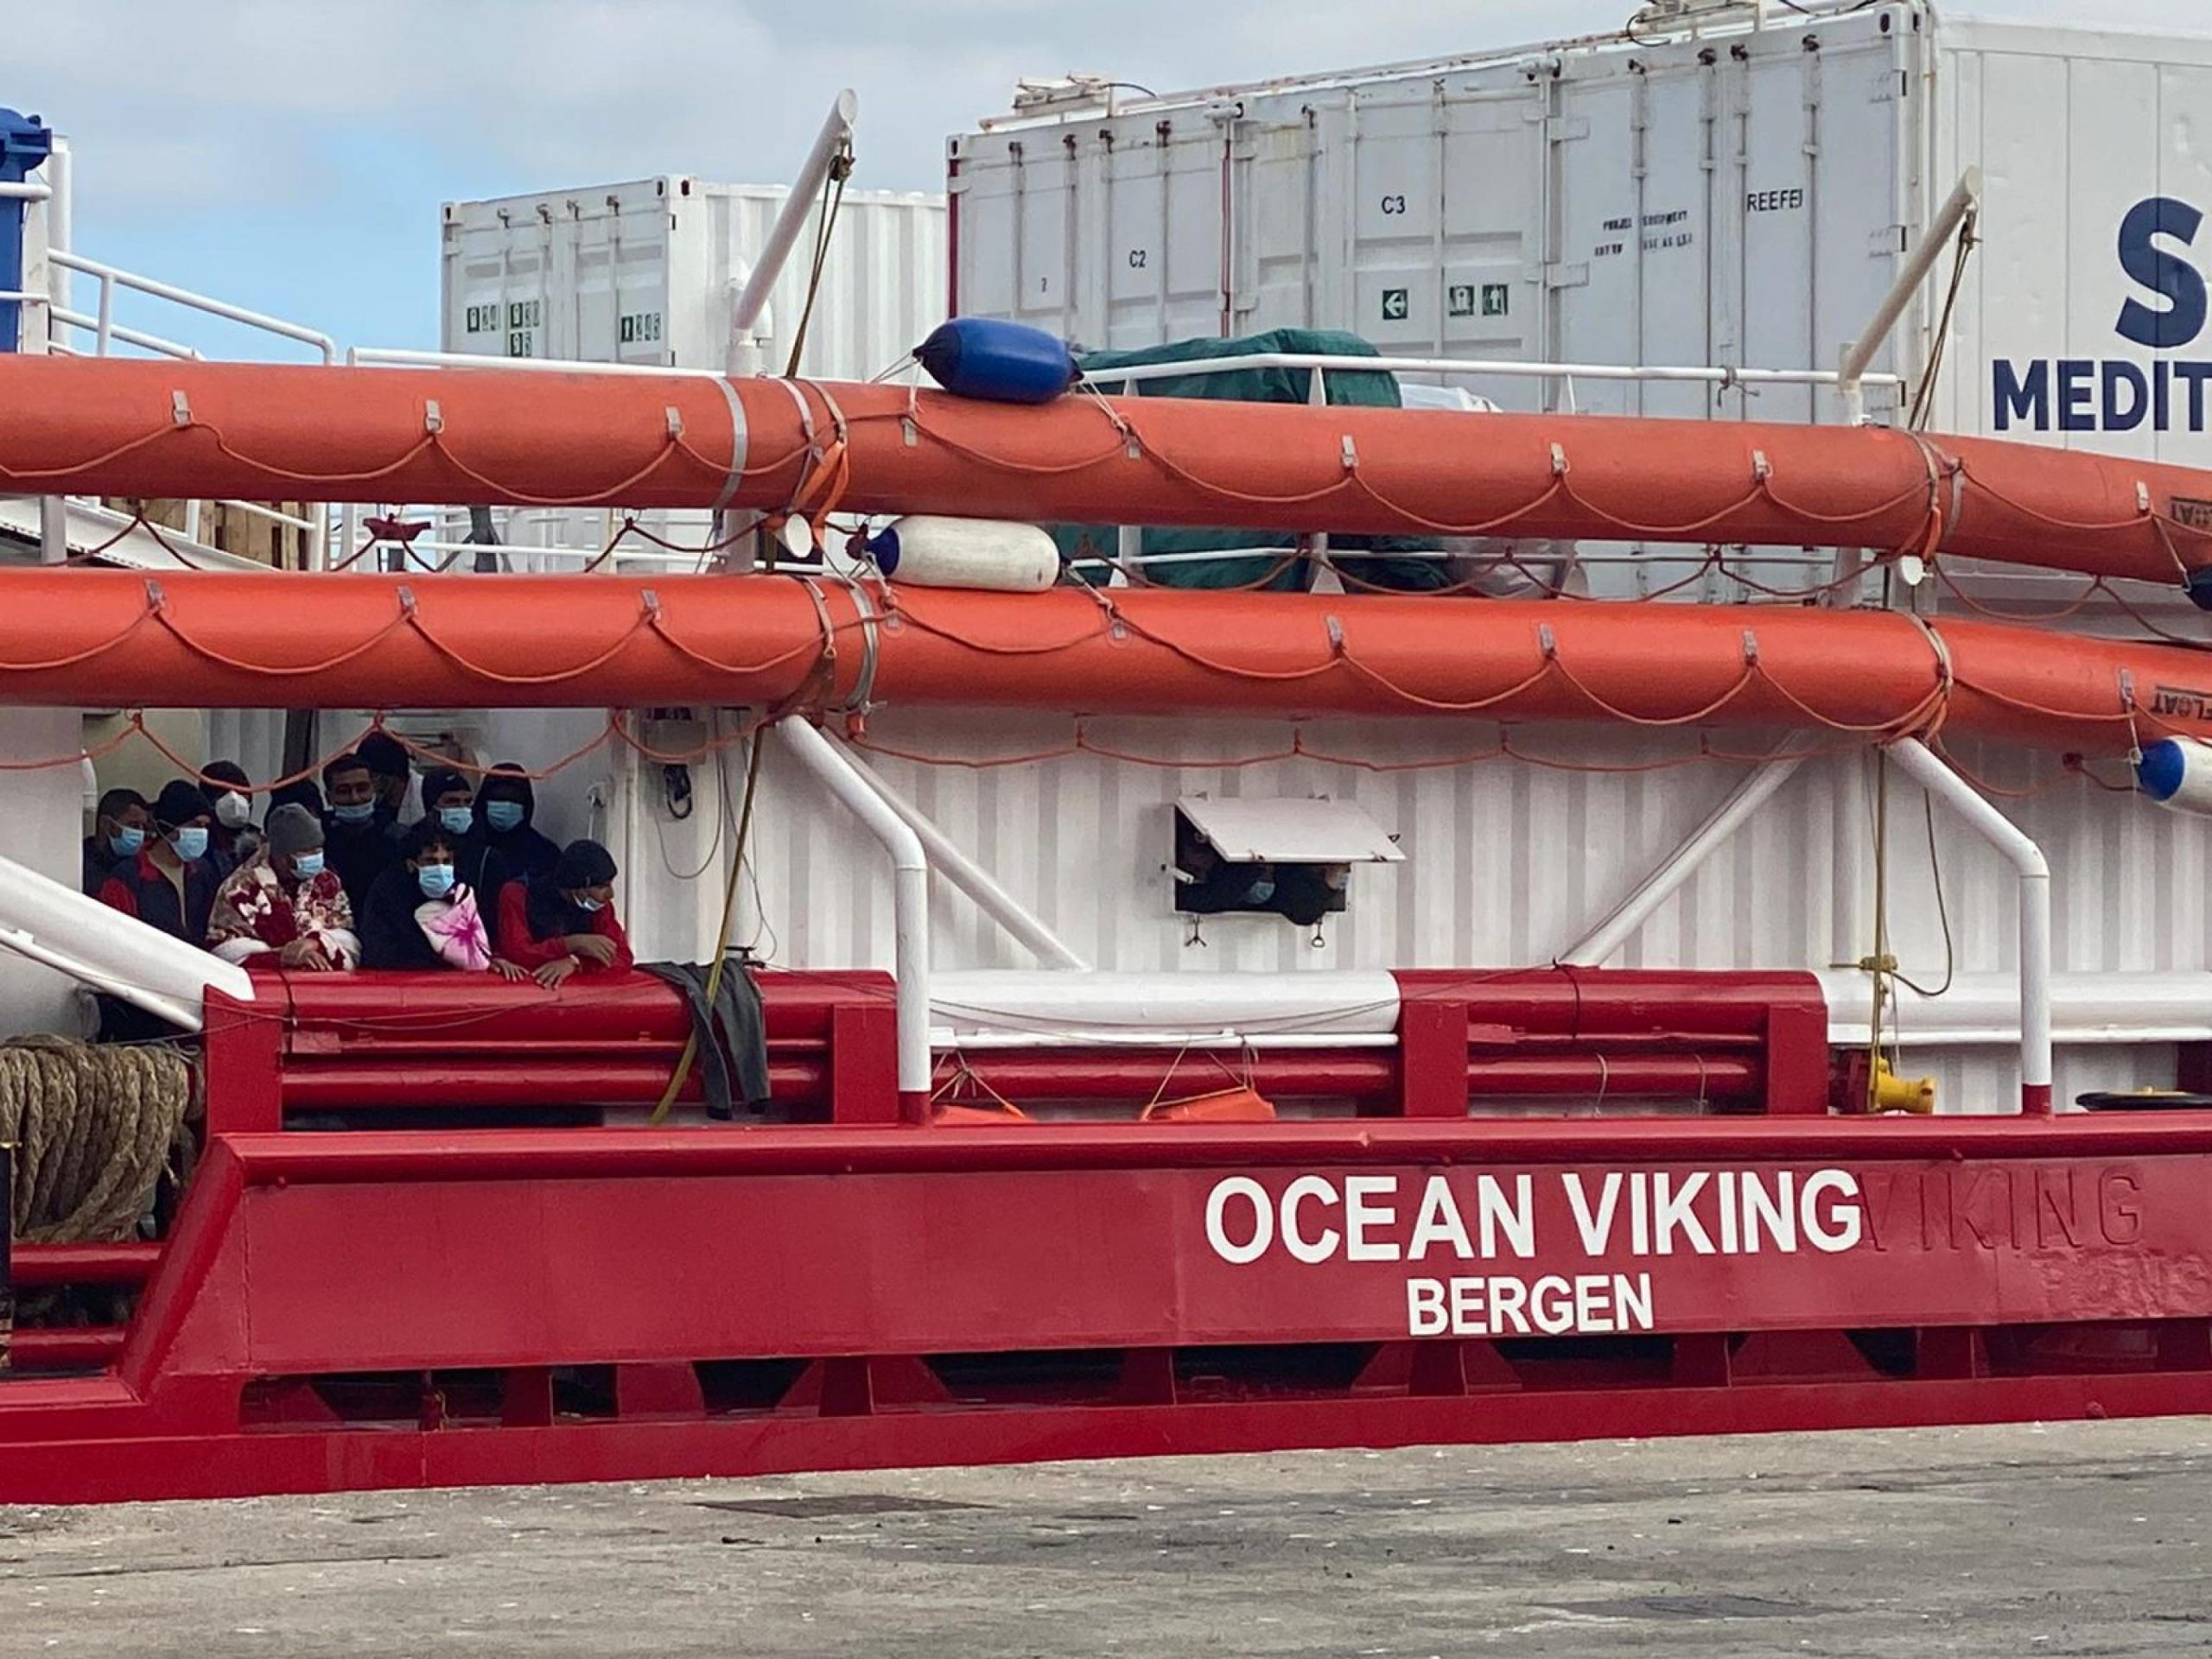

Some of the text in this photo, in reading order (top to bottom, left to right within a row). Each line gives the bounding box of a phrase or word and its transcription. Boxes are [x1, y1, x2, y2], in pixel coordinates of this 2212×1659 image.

[1382, 195, 1405, 214] C3
[1128, 250, 1147, 268] C2
[2114, 197, 2208, 348] S
[1993, 359, 2212, 431] MEDIT
[1205, 1169, 1862, 1265] OCEAN VIKING
[1407, 1273, 1654, 1337] BERGEN
